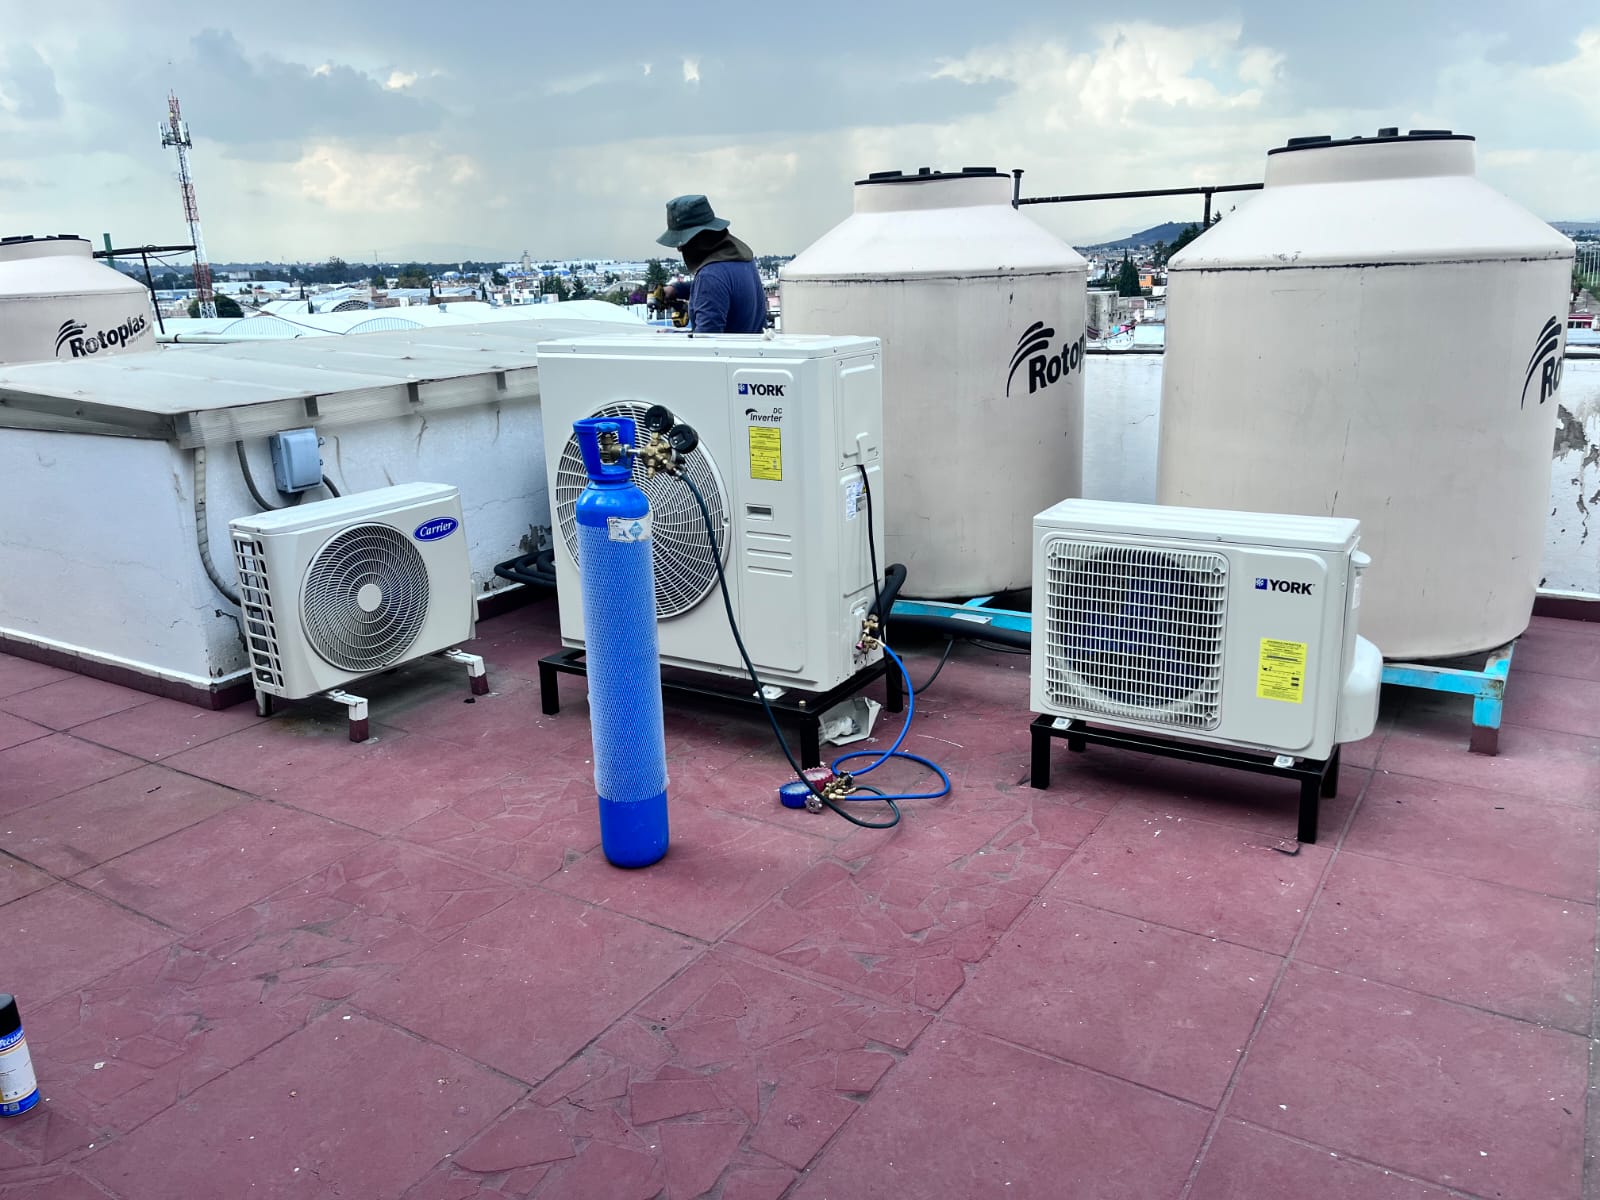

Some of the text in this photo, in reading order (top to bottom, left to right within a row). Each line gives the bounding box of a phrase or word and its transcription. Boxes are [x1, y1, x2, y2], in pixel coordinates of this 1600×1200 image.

[69, 313, 145, 357] Rotoplas
[749, 383, 785, 397] YORK
[420, 522, 453, 537] Carrier
[1270, 579, 1312, 596] YORK
